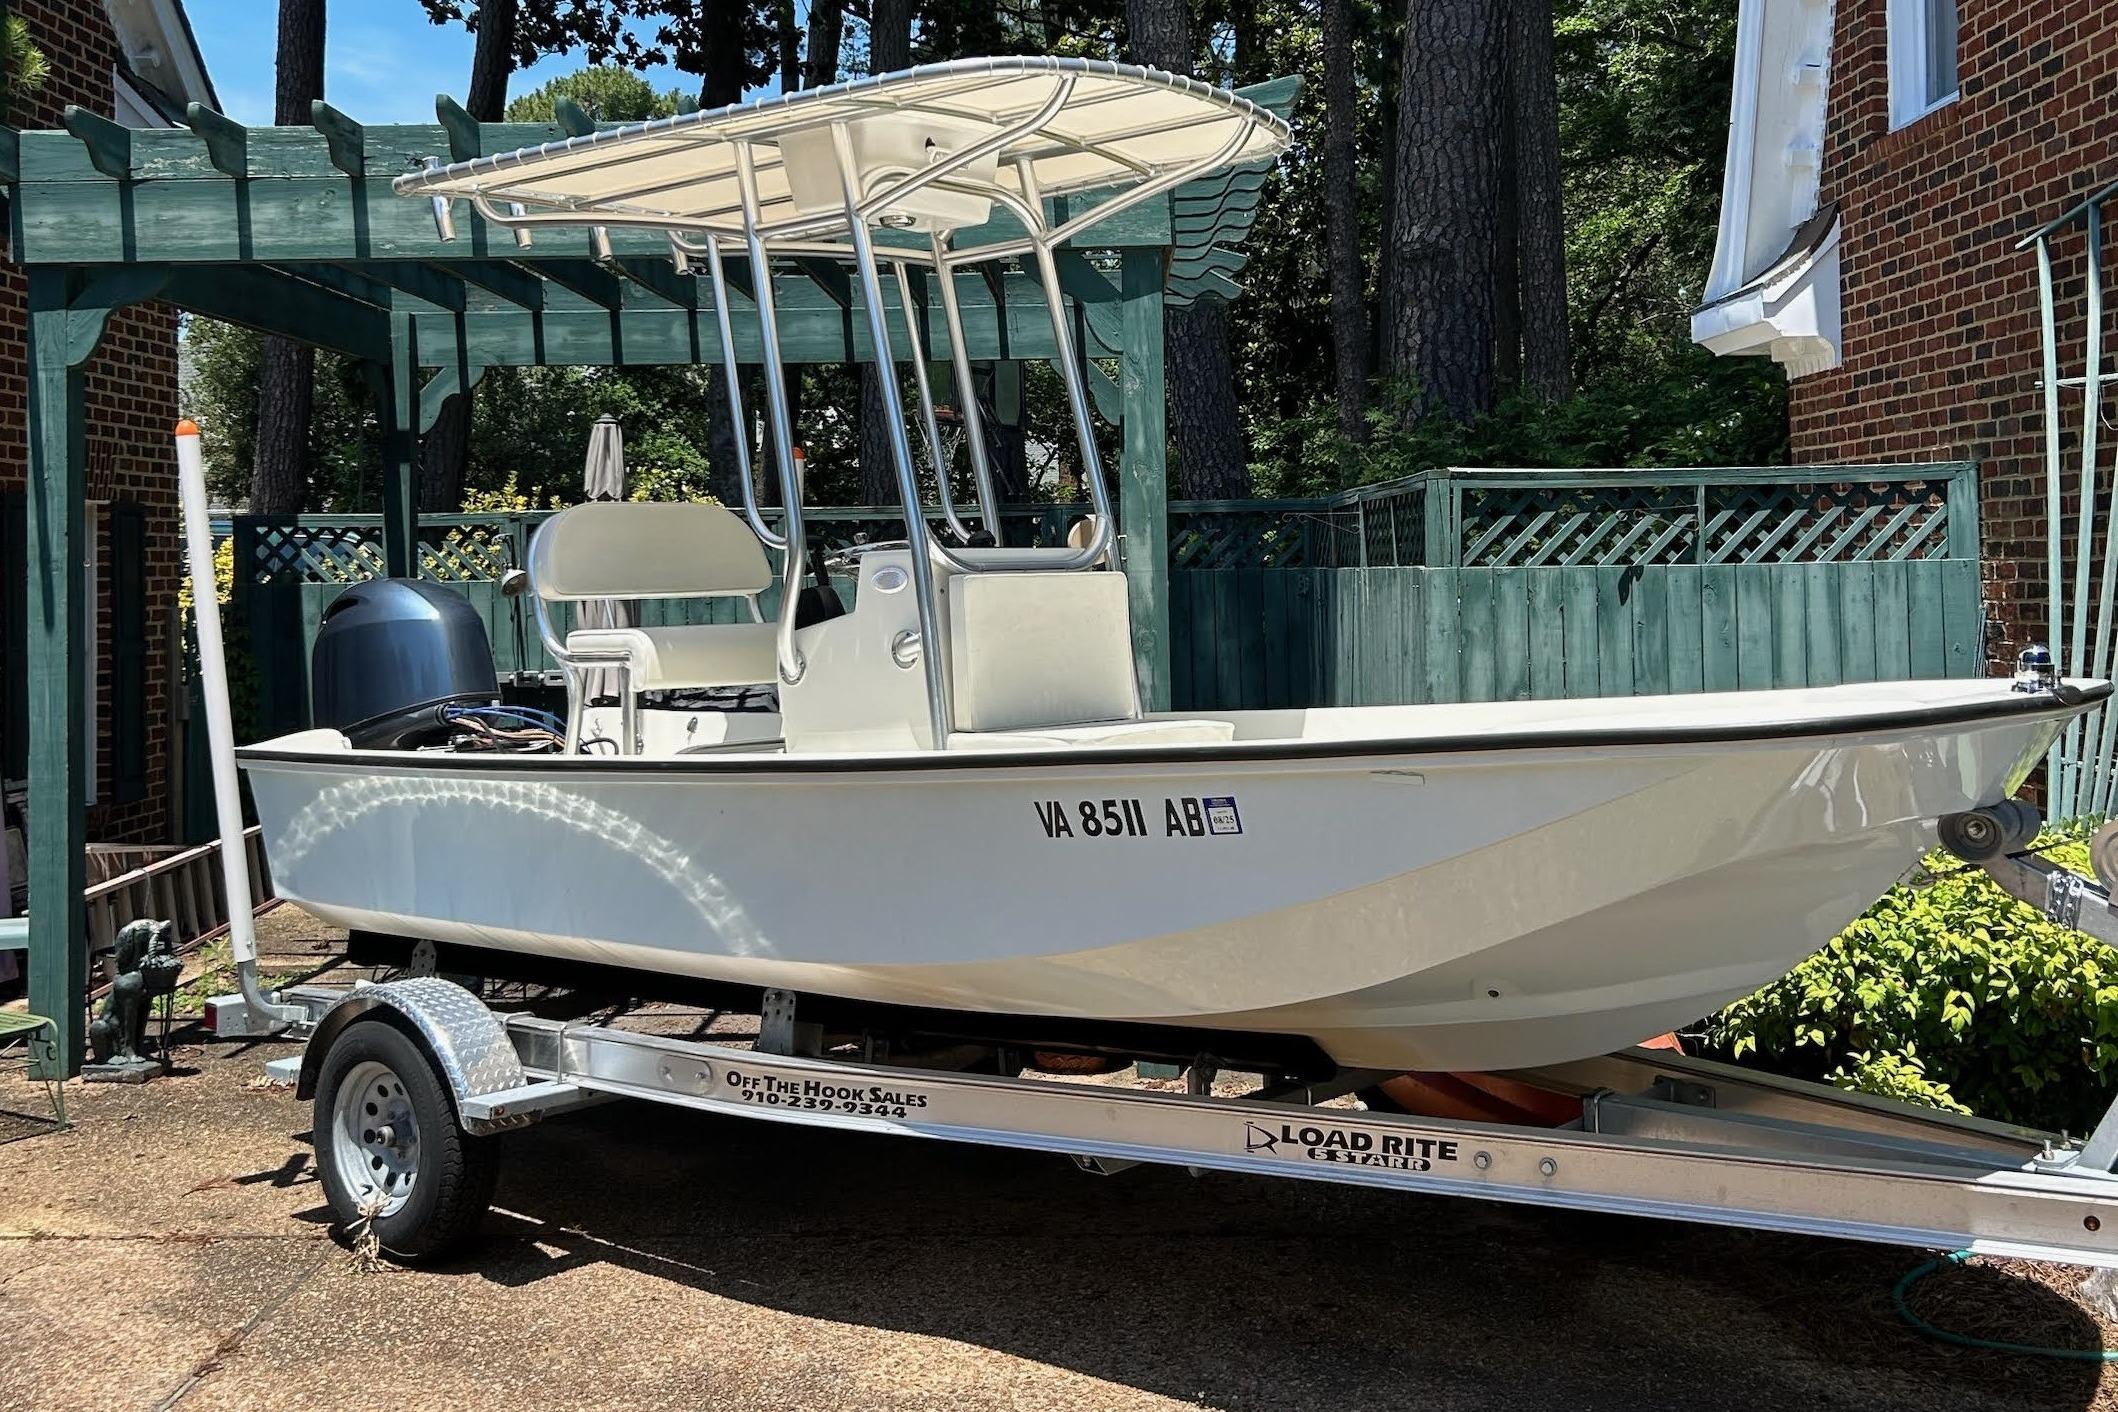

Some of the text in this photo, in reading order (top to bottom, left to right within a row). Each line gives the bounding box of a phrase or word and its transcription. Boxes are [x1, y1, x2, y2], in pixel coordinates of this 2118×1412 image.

[1034, 798, 1205, 838] VA 8511 AB
[727, 1071, 928, 1108] OFF THE HOOK SALES
[741, 1089, 907, 1119] 910-239-9344
[1281, 1124, 1458, 1161] LOAD RITE
[1335, 1150, 1424, 1172] STARR
